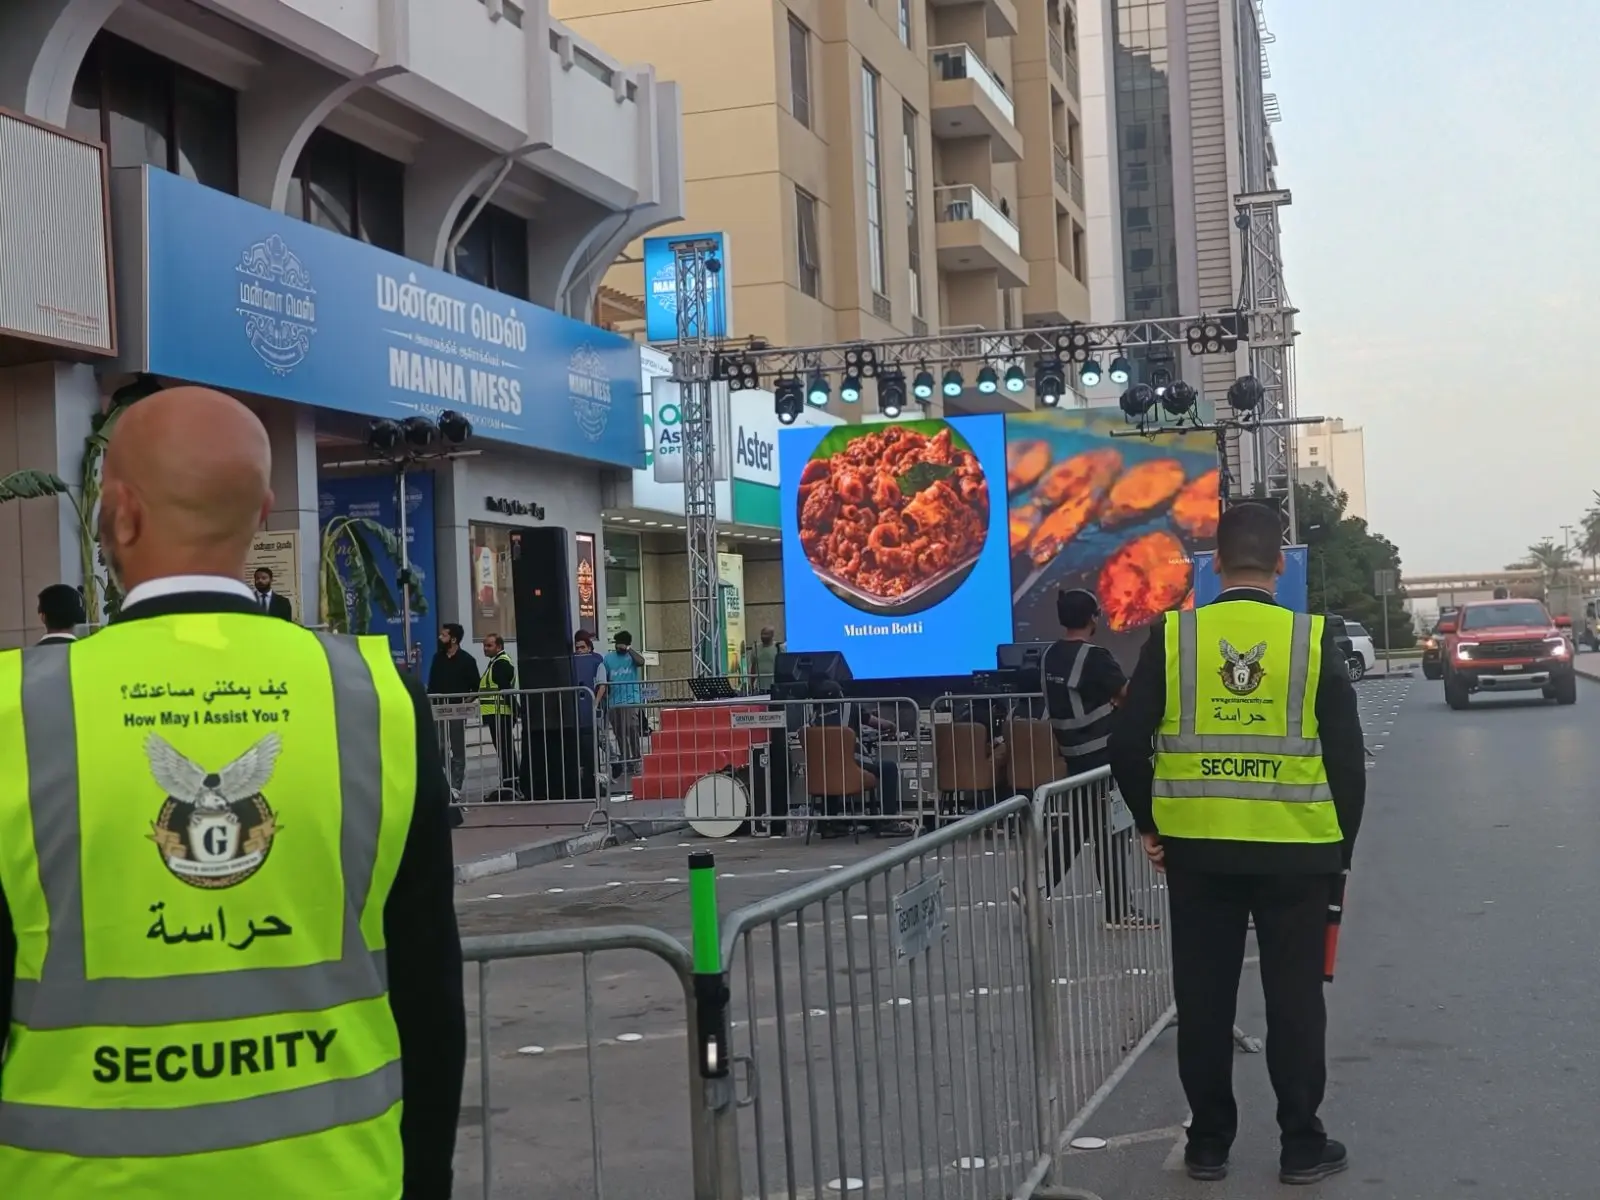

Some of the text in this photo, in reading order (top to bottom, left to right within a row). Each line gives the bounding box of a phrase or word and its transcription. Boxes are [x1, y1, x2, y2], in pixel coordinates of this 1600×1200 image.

[377, 272, 527, 352] மன்னா மெஸ்
[389, 347, 522, 415] MANNA MESS
[736, 425, 774, 471] Aster
[844, 620, 923, 637] Mutton Botti
[259, 679, 288, 700] كيف
[1237, 672, 1246, 684] G
[203, 681, 251, 704] يمكنني
[124, 713, 156, 727] How
[161, 711, 189, 728] May
[194, 711, 199, 724] I
[204, 709, 248, 724] Assist
[252, 709, 279, 723] You
[1214, 706, 1266, 725] حراسة
[1201, 758, 1282, 779] SECURITY
[203, 825, 228, 856] G
[146, 901, 292, 951] حراسة
[93, 1028, 338, 1083] SECURITY
